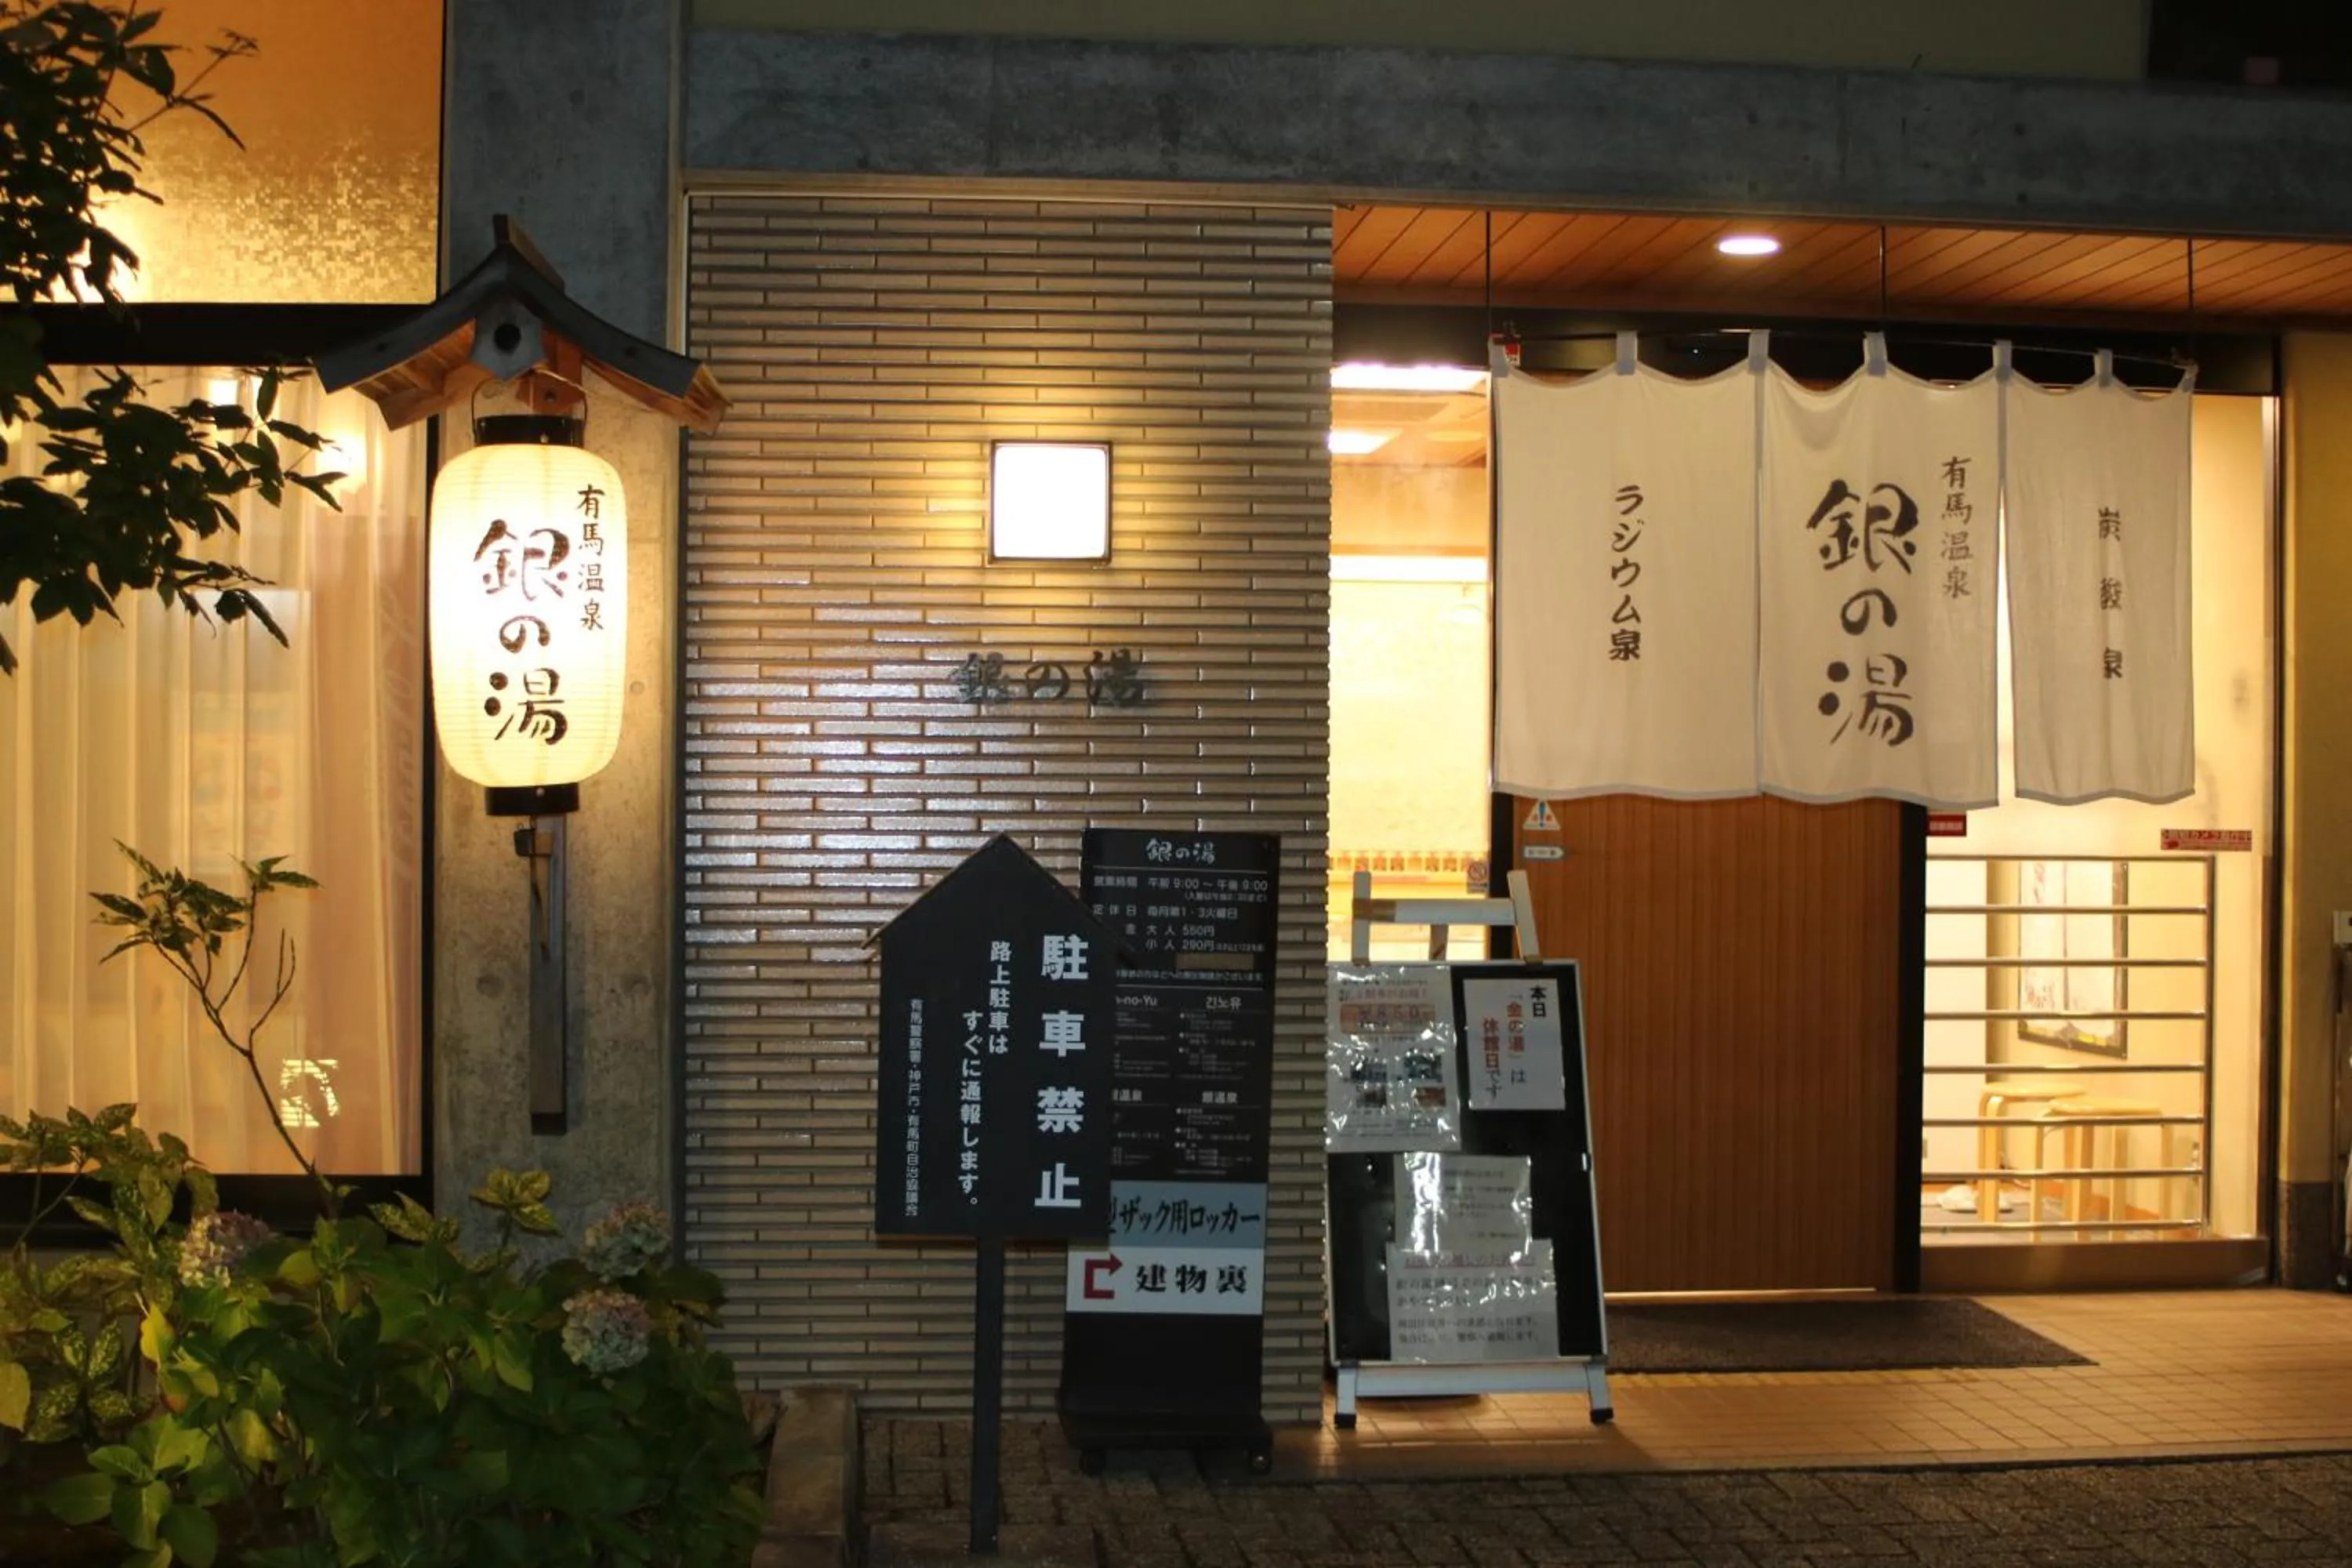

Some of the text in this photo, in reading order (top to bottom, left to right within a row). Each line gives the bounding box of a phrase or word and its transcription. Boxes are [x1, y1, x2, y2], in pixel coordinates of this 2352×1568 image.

[576, 482, 606, 631] 有馬温泉
[1608, 483, 1645, 662] ラジウム泉
[1940, 454, 1974, 600] 有馬温泉
[473, 517, 571, 746] 銀の湯
[1805, 477, 1921, 749] 銀の湯
[1145, 837, 1217, 865] 銀の湯
[988, 939, 1012, 1055] 路上駐車は
[1033, 933, 1090, 1208] 駐車禁止
[1530, 985, 1548, 1018] 本日
[957, 1010, 984, 1206] すぐに通報します。
[1136, 1263, 1247, 1295] 建物裏
